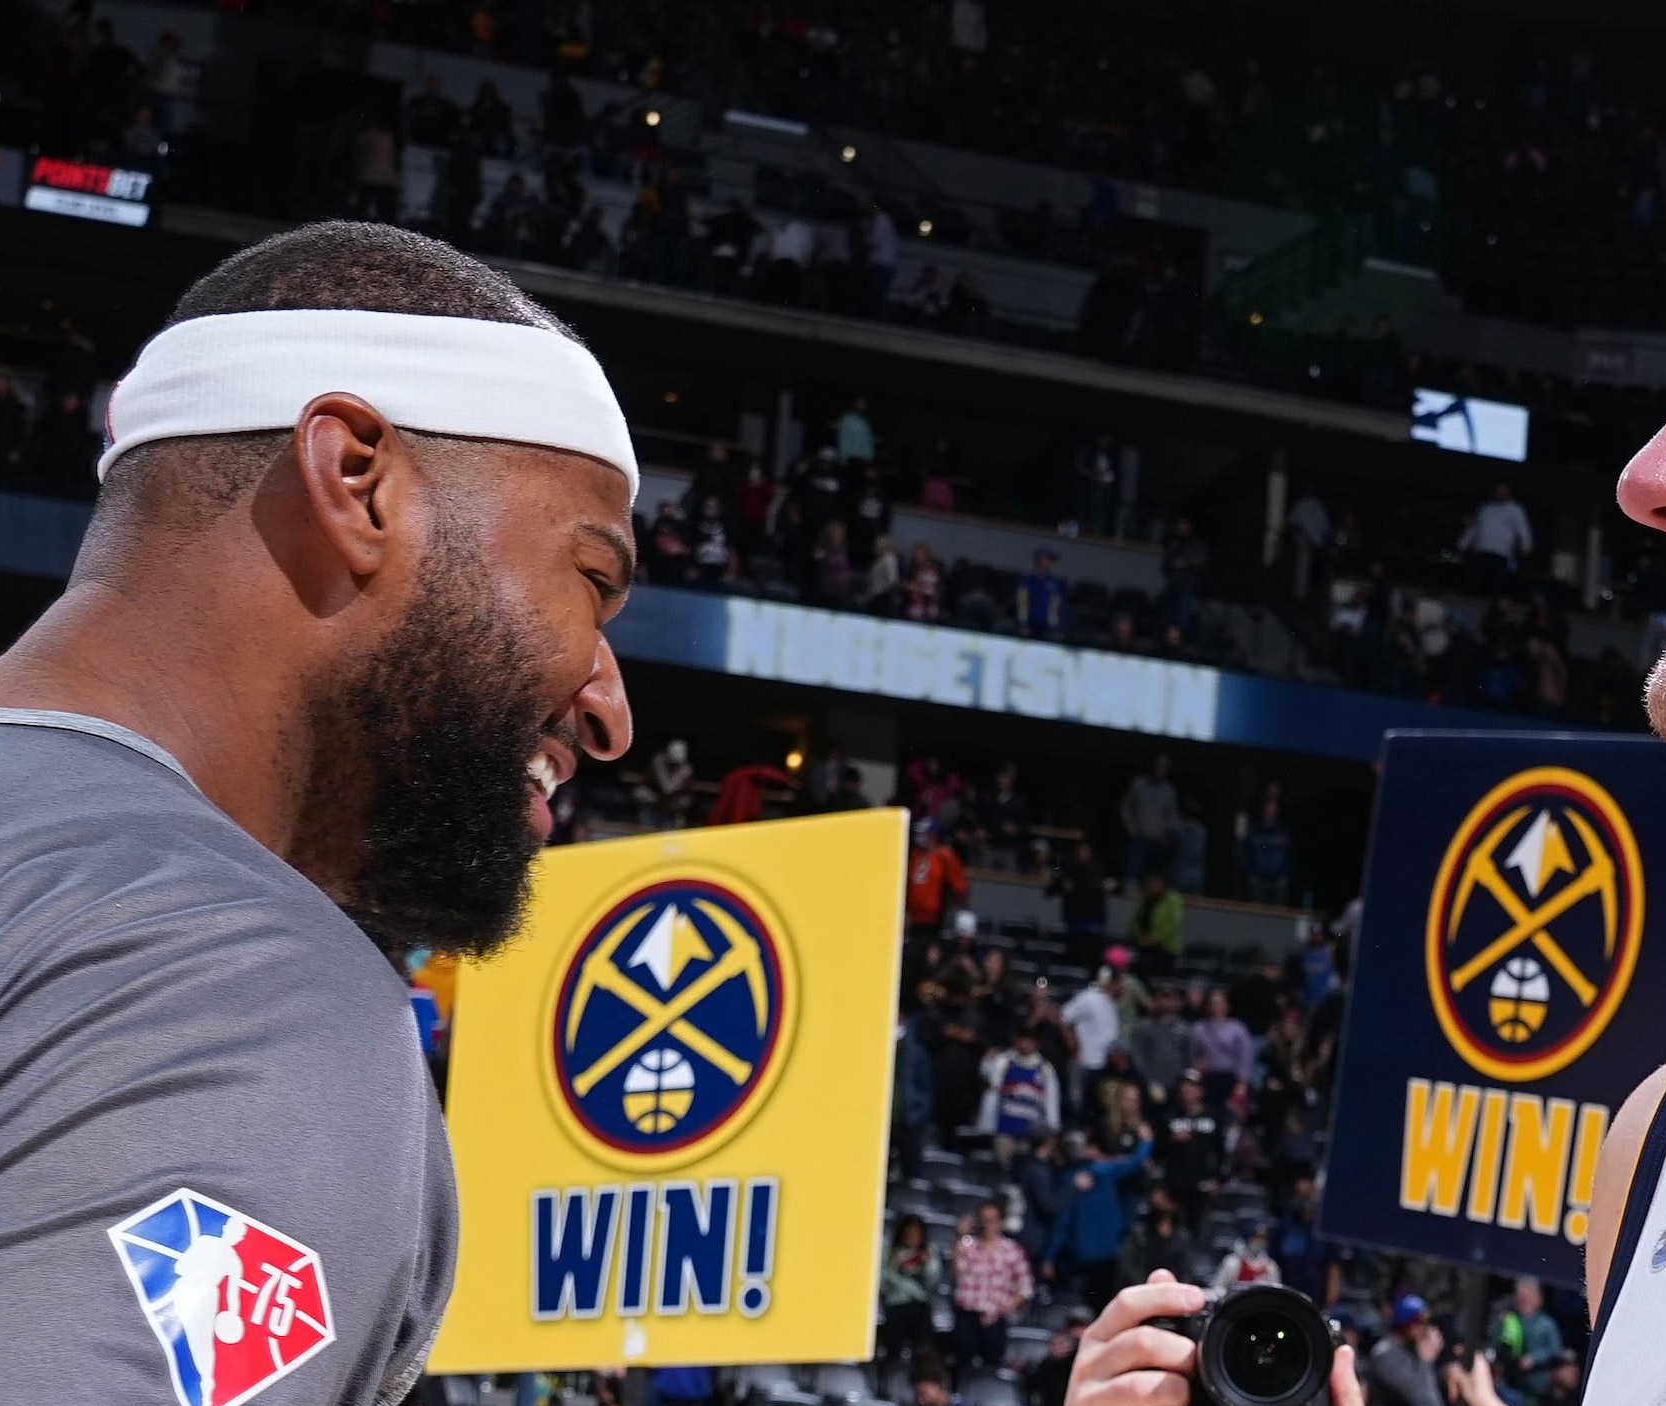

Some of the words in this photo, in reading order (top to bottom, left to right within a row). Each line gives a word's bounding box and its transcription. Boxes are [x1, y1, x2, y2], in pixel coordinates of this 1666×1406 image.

[1399, 1076, 1611, 1245] WIN!
[251, 1262, 303, 1337] 75
[530, 1175, 780, 1322] WIN!
